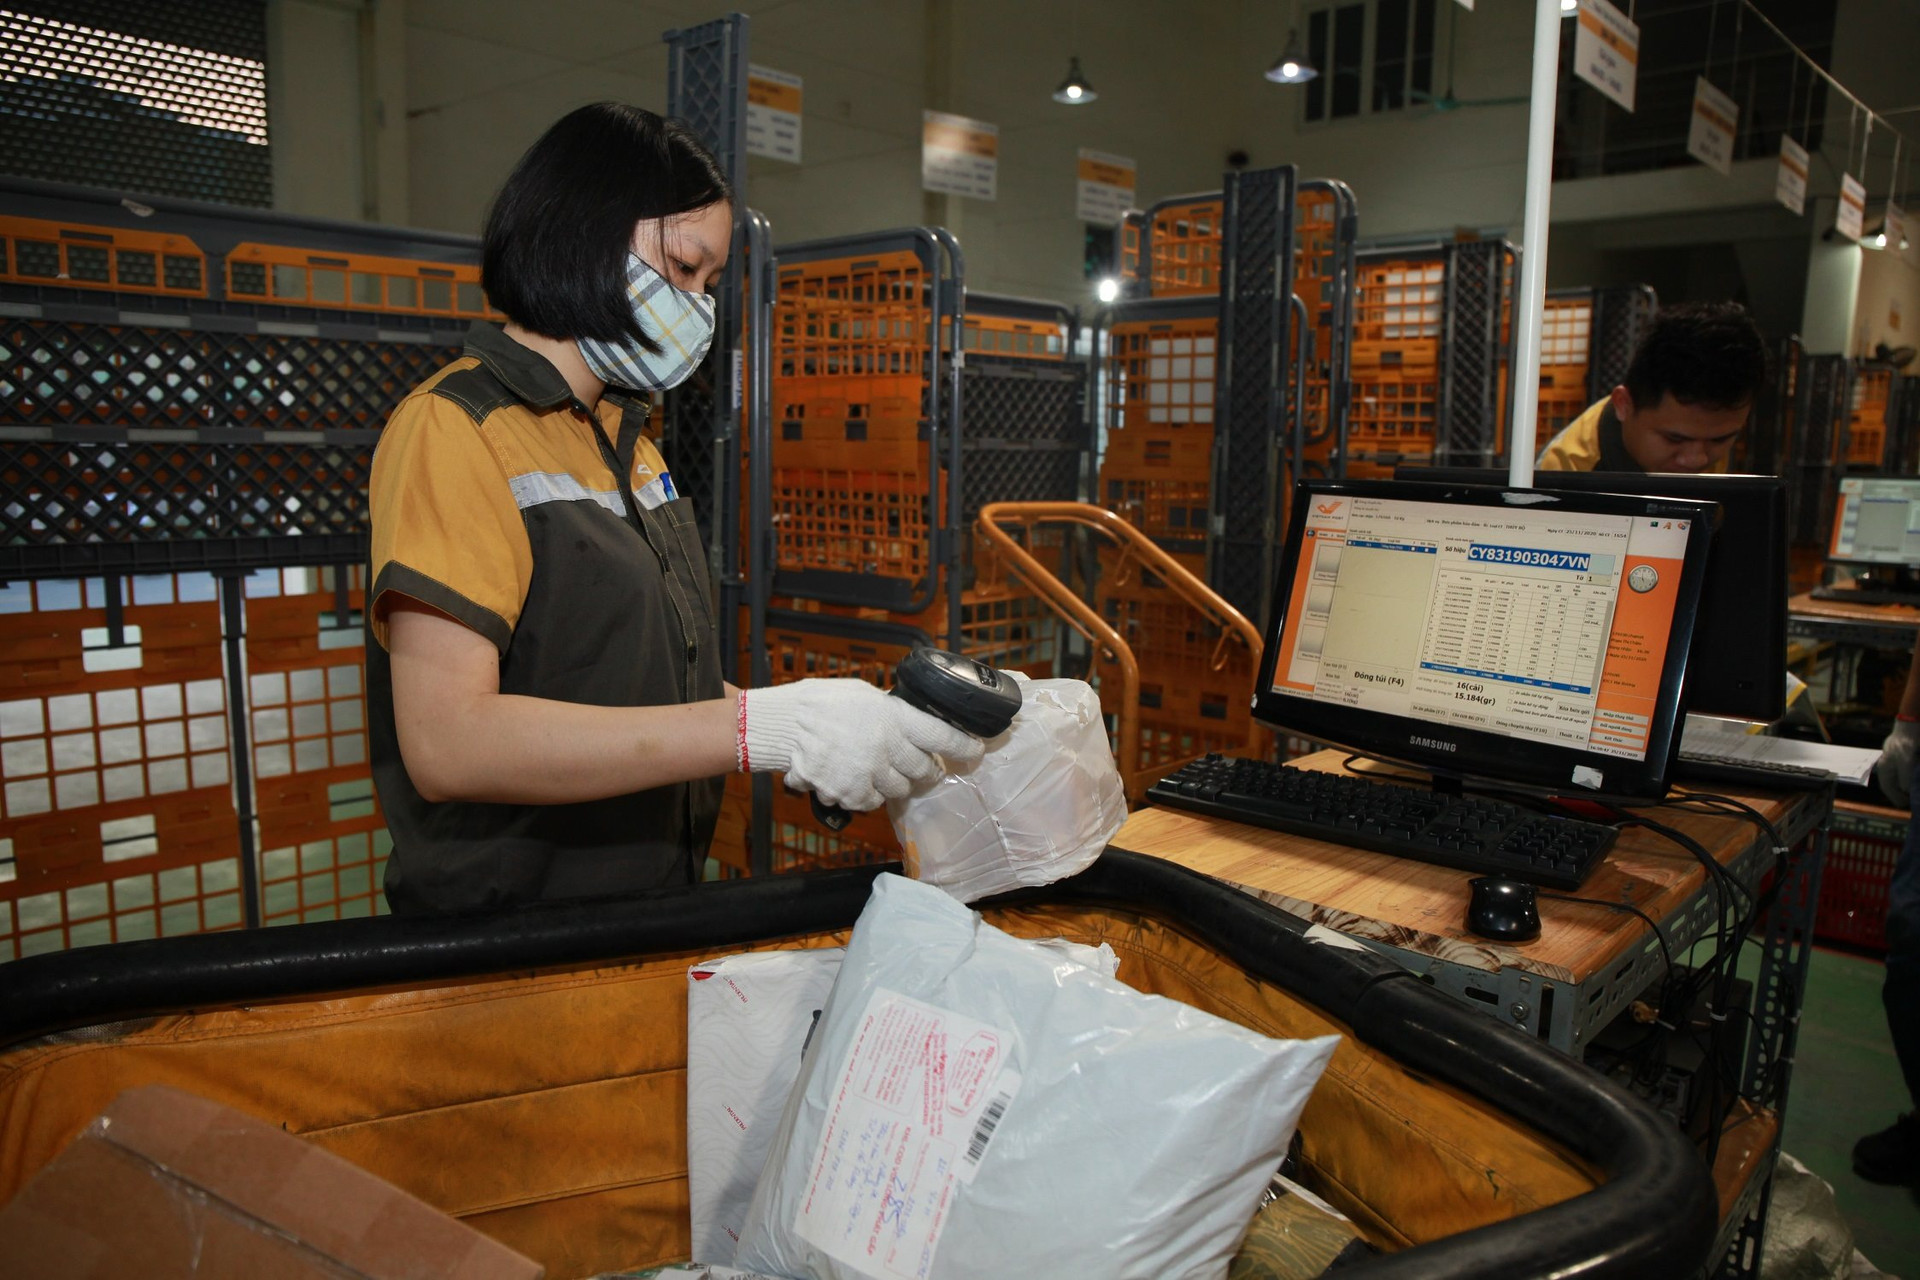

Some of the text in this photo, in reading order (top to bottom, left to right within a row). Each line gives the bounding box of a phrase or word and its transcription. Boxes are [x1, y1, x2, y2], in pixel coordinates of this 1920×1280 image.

[1468, 545, 1589, 569] CY831903047VN
[1353, 670, 1404, 687] Đóng túi (F4)
[1456, 681, 1484, 693] 16(cái)
[1454, 691, 1496, 706] 15.184(gr)
[1410, 735, 1457, 752] SAMSUNG
[727, 978, 748, 1003] PRUDENTIAL
[725, 1106, 746, 1131] PRUDENTIAL
[879, 1175, 912, 1227] 285
